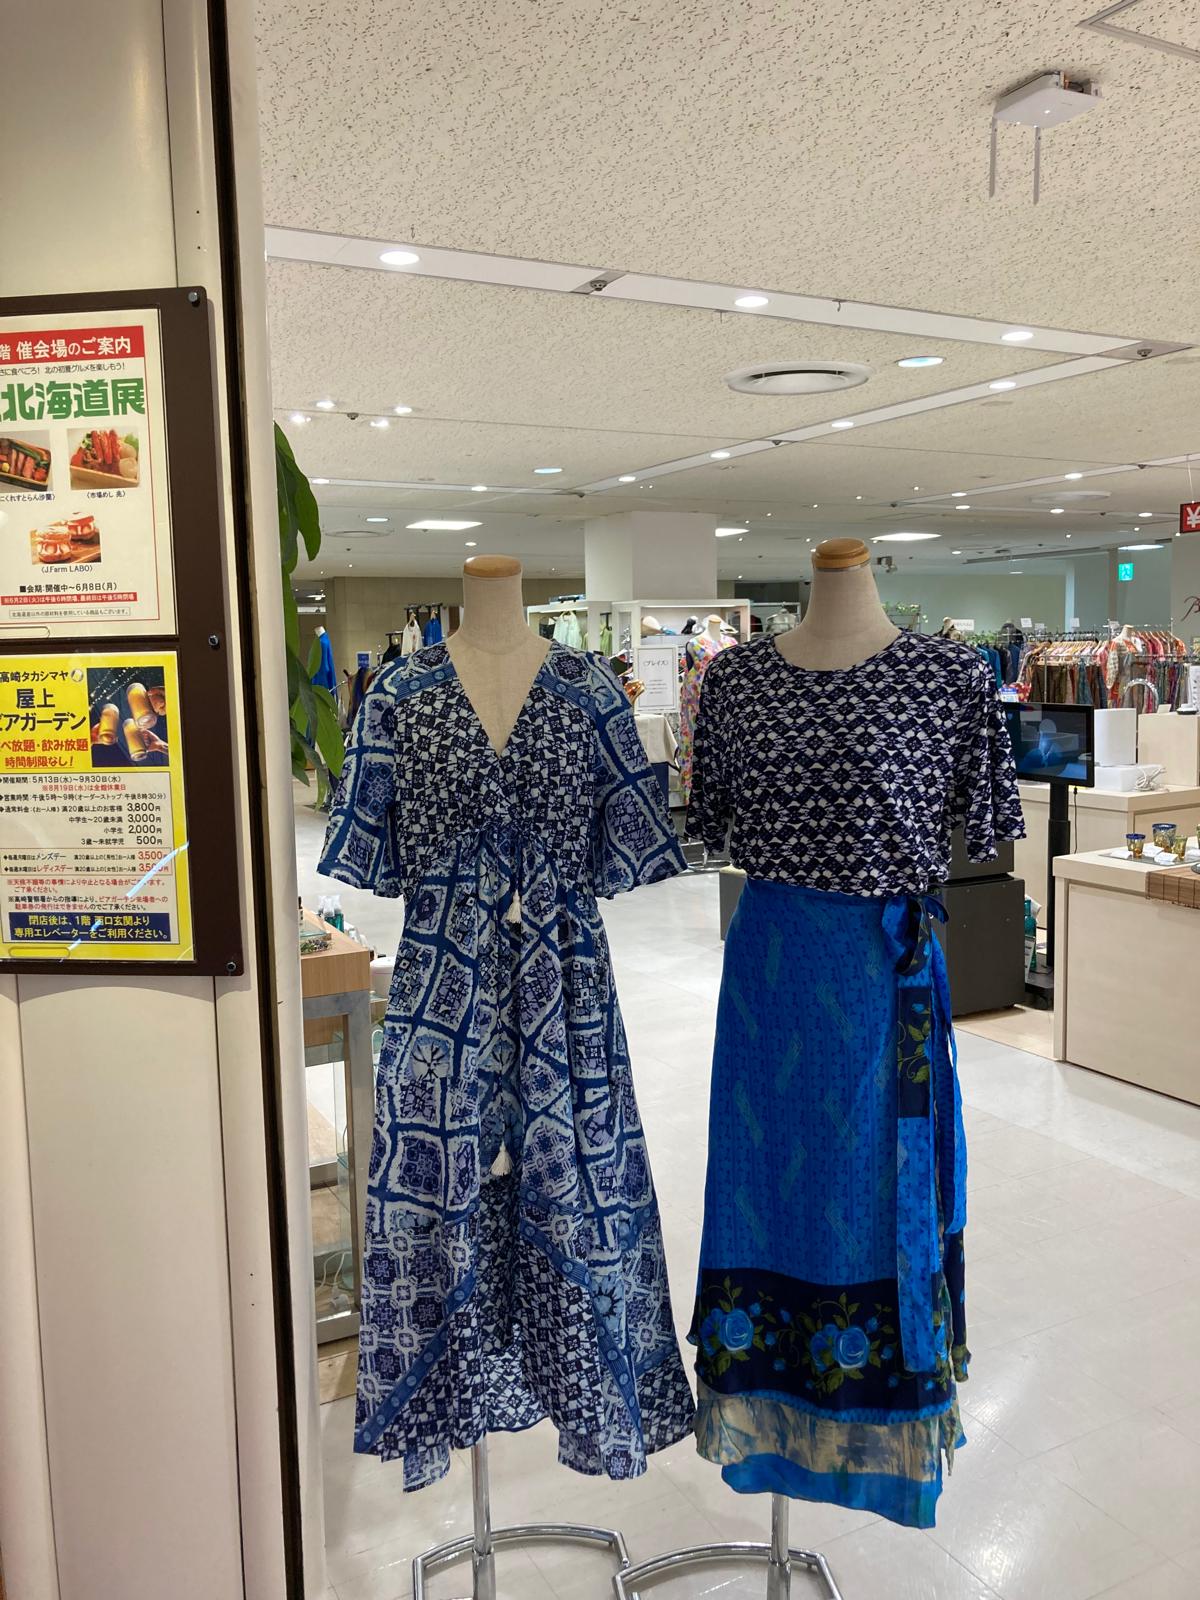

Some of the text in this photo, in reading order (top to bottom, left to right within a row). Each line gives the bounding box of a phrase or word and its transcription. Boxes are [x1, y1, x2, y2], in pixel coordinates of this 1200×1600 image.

[16, 336, 131, 361] 催会場のご案内
[0, 378, 146, 422] 北海道展
[0, 670, 69, 682] 高崎タカシマヤ
[16, 688, 55, 709] 屋上
[0, 712, 86, 732] アガーデン
[1, 738, 88, 752] べ放題・飲み放題
[5, 755, 73, 768] 時間制限なし！
[127, 802, 161, 813] 3,800円
[127, 813, 161, 823] 3,000円
[128, 825, 162, 835] 2,000円
[136, 836, 162, 845] 500円
